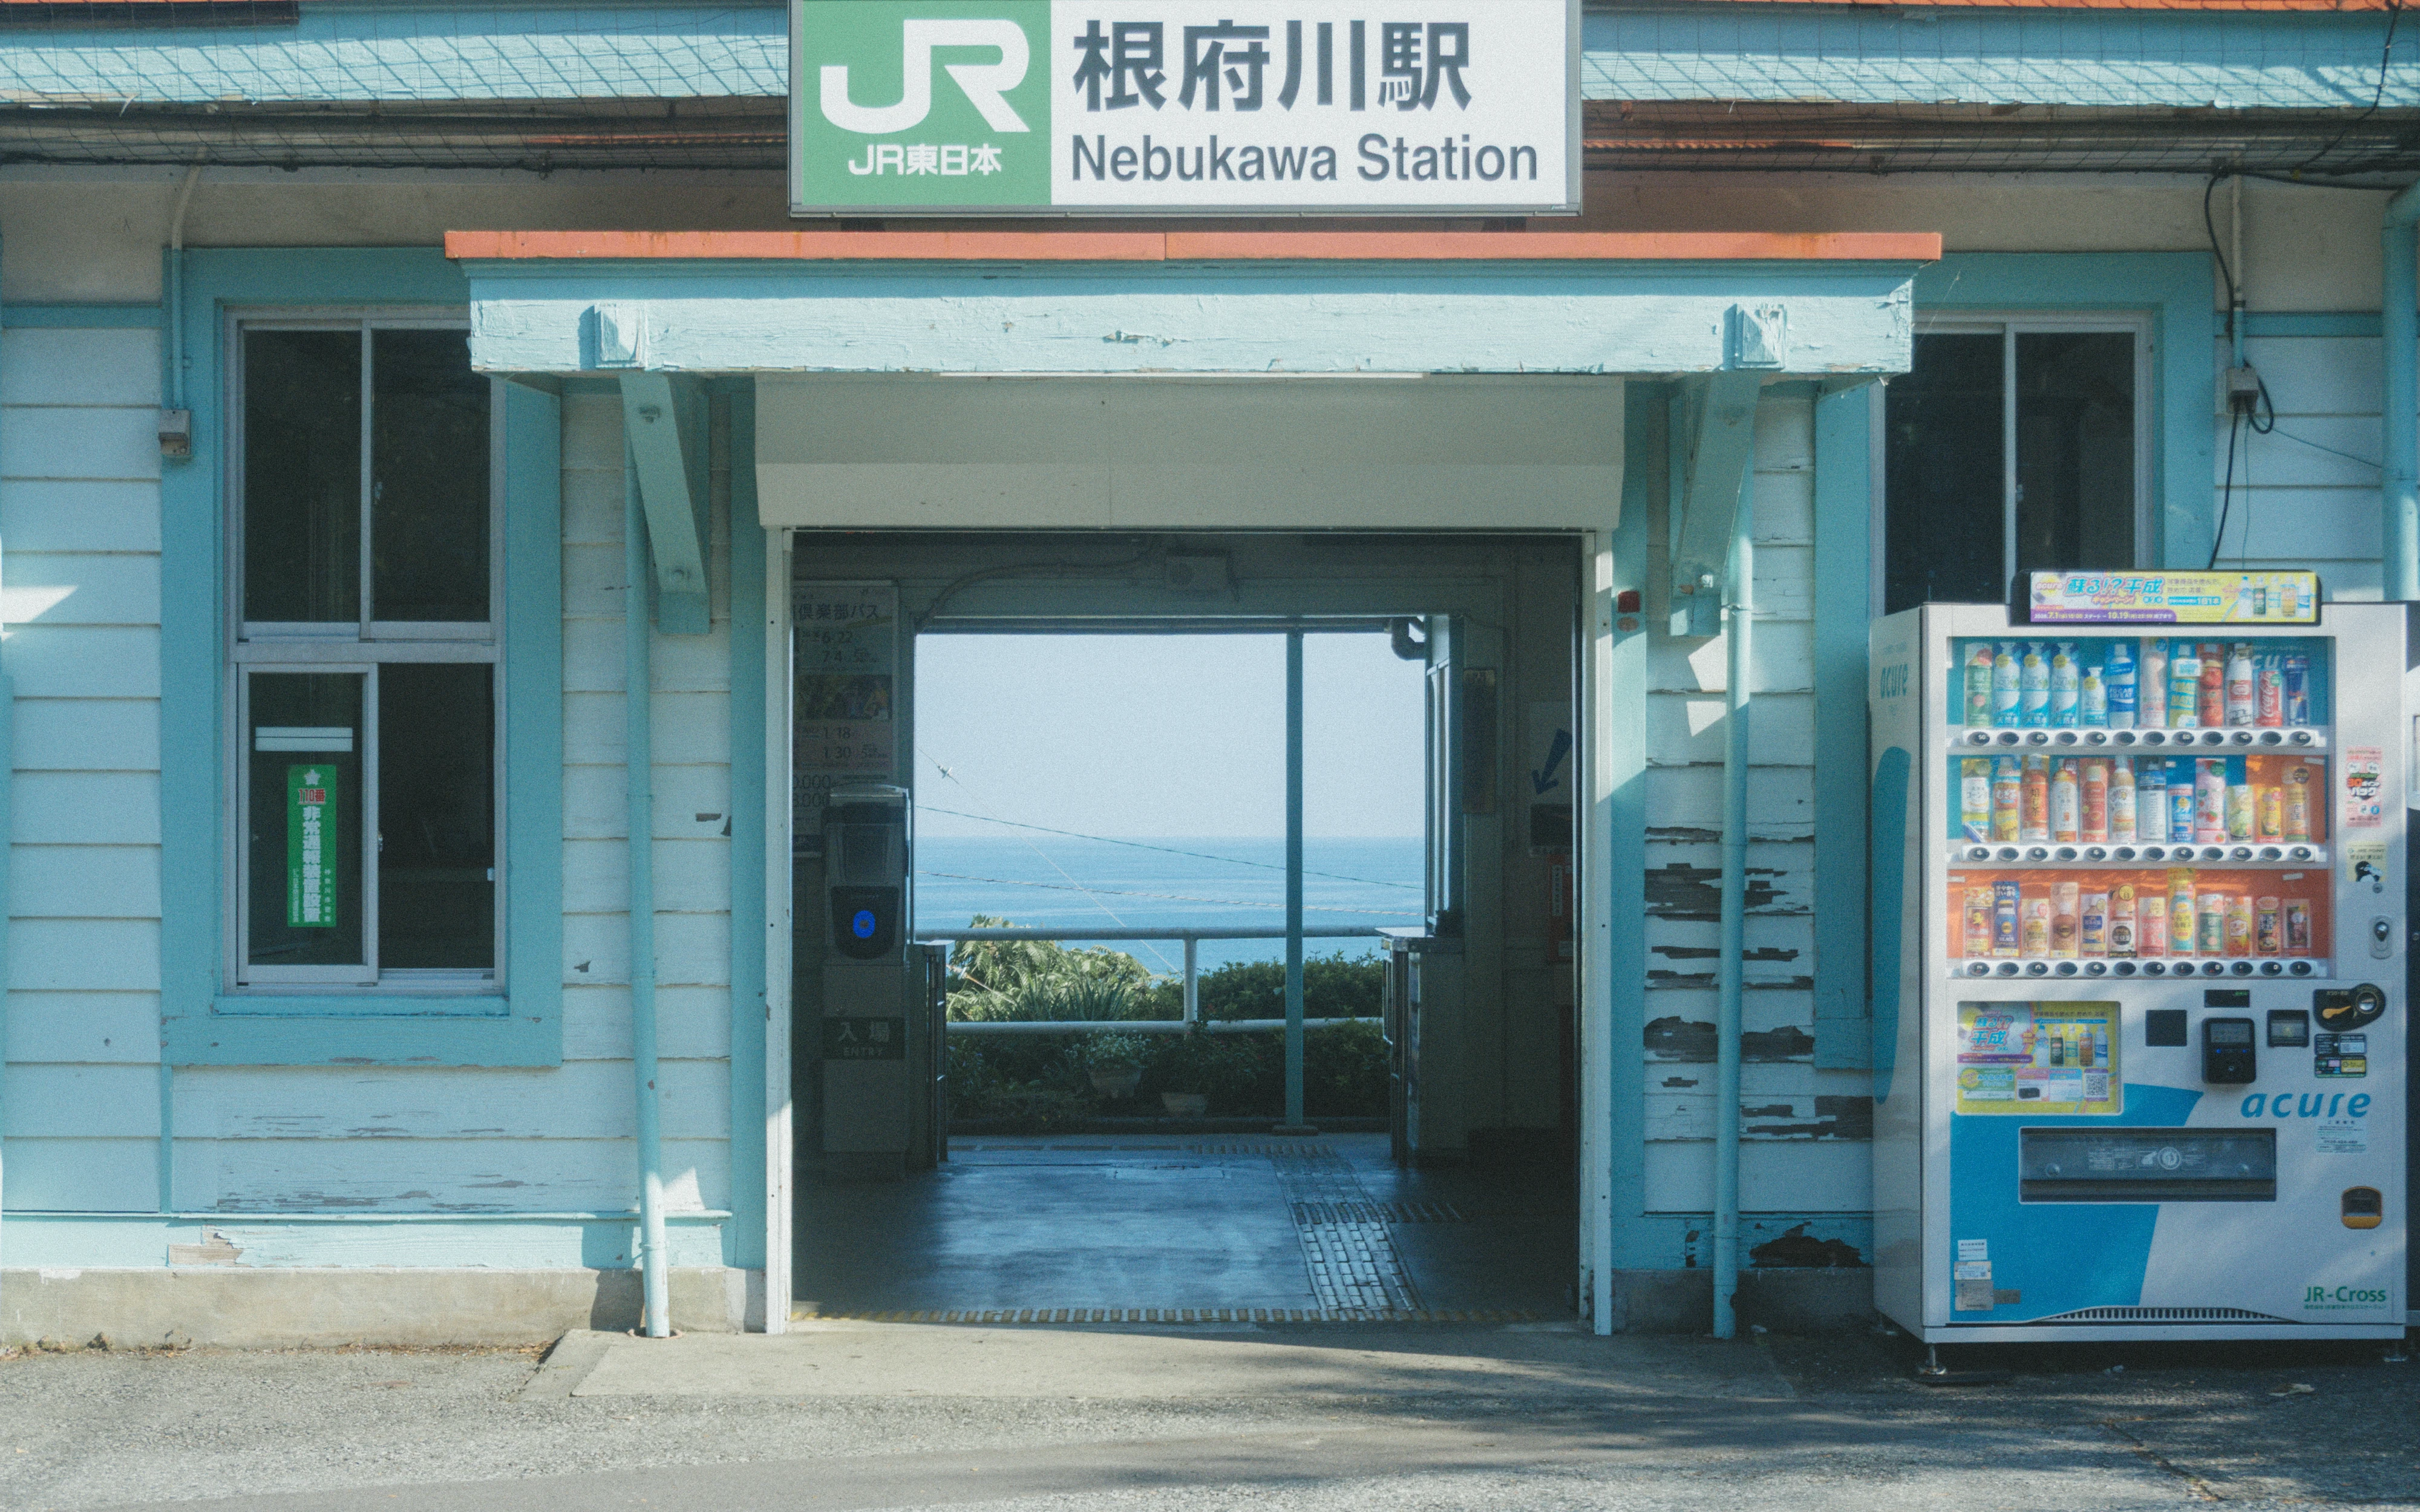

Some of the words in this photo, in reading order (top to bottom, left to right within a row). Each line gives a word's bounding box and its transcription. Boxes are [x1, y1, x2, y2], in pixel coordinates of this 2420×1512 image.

[820, 19, 1030, 134] JR
[1073, 19, 1472, 111] 根府川駅
[848, 143, 1002, 175] JR東日本
[1073, 135, 1337, 181] Nebukawa
[1358, 133, 1537, 181] Station
[1880, 664, 1909, 700] acure
[298, 788, 326, 804] 110番
[838, 1022, 889, 1042] 入場
[1971, 1030, 2007, 1046] 平成
[843, 1047, 883, 1057] ENTRY
[2241, 1093, 2371, 1118] acure
[2304, 1286, 2387, 1302] JR-Cross
